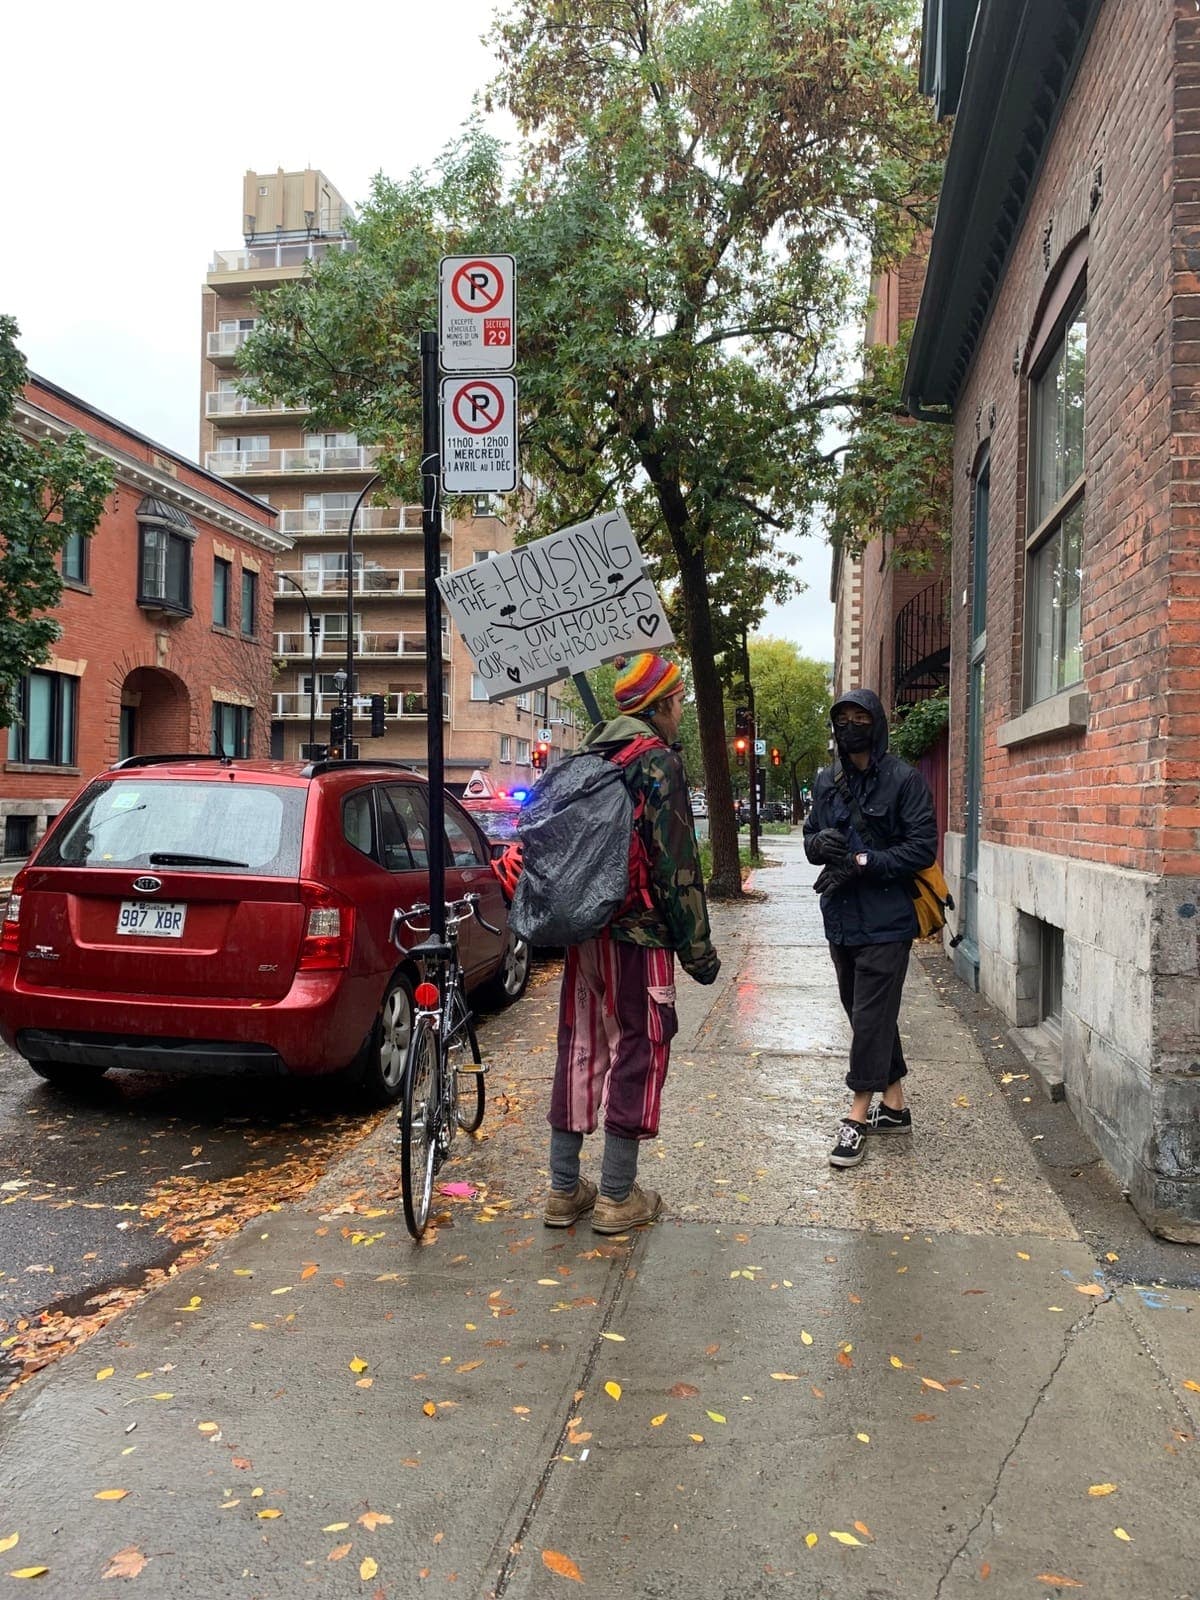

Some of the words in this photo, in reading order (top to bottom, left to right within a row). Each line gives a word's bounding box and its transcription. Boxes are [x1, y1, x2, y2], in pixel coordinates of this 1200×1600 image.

[485, 320, 510, 329] SECTEUR
[488, 330, 507, 345] 29
[447, 437, 474, 448] 11h00
[482, 436, 509, 447] 12h00
[454, 448, 504, 460] MERCREDI
[453, 461, 477, 472] AVRIL
[480, 463, 488, 472] AU
[492, 519, 632, 601] HOUSING
[440, 569, 484, 601] HATE
[458, 589, 497, 616] THE
[519, 580, 608, 621] CRISIS
[466, 627, 503, 658] LOVE
[478, 651, 512, 679] OUR
[137, 879, 157, 889] KIA
[121, 909, 148, 928] 987
[155, 911, 182, 930] XBR
